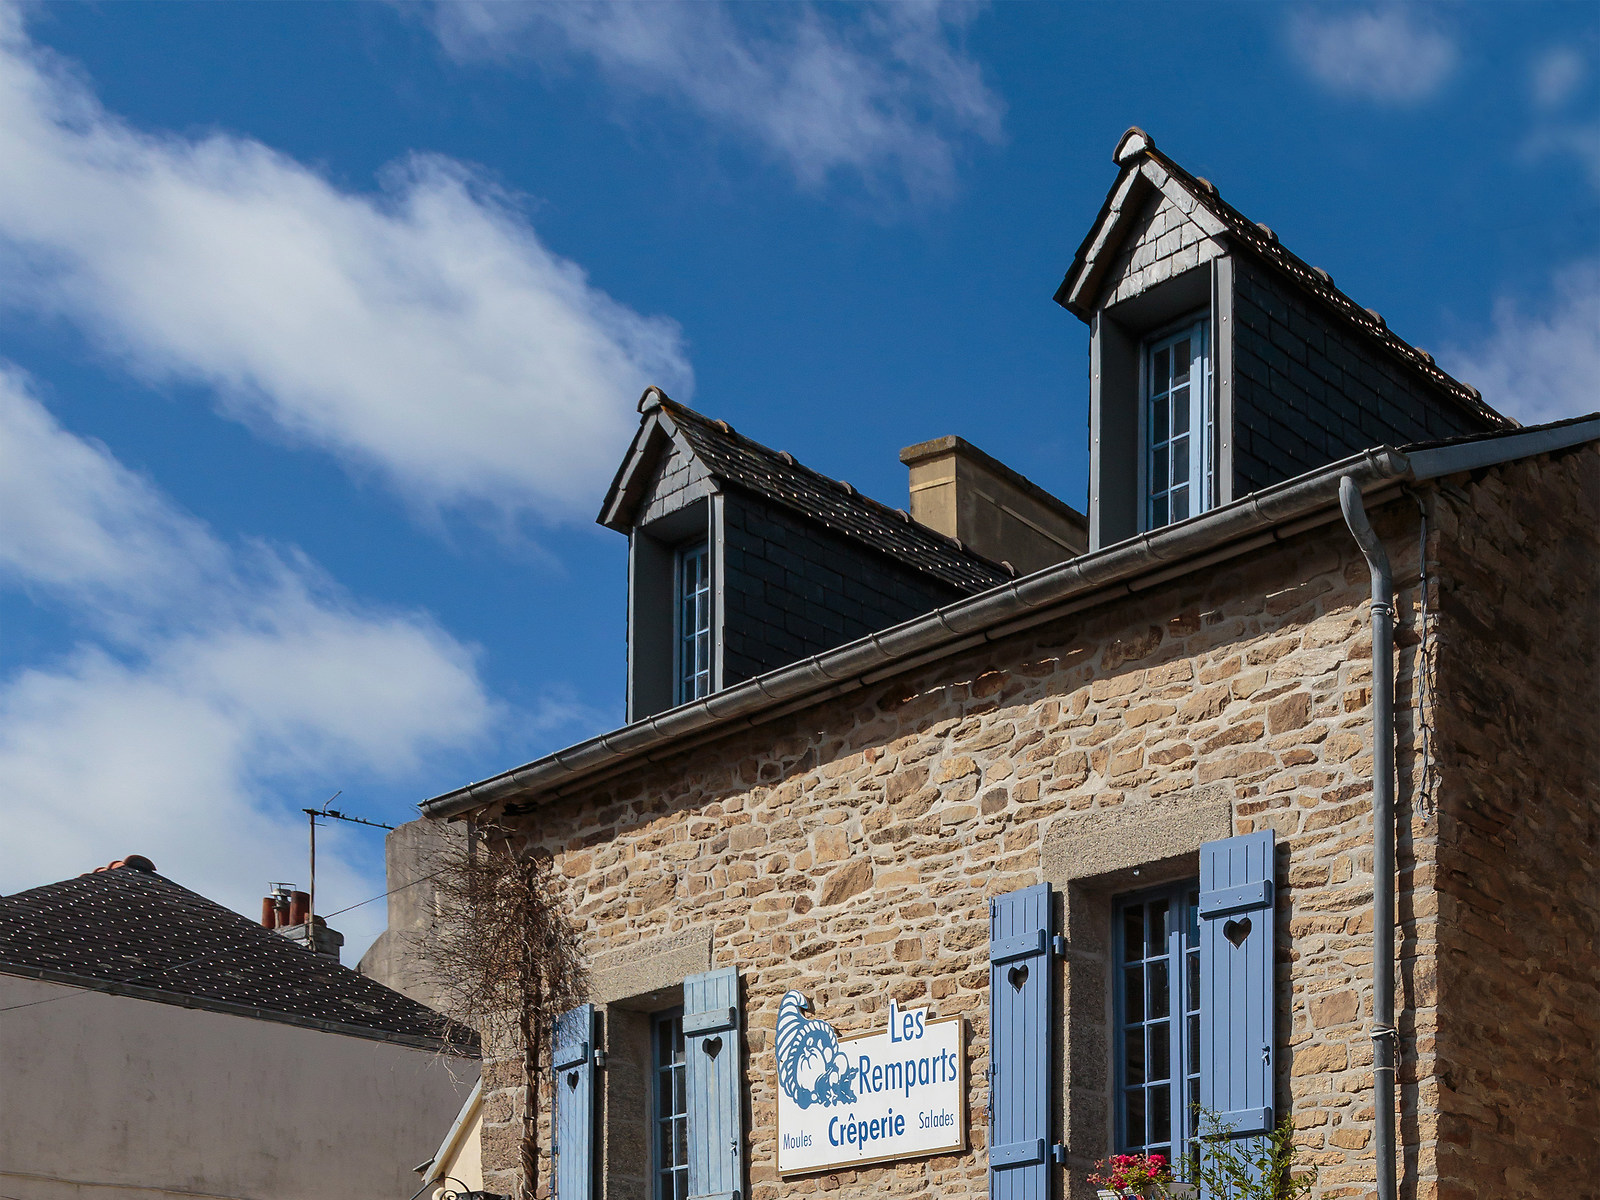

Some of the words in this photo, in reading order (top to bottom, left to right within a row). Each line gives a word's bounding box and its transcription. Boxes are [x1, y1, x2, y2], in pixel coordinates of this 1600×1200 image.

[891, 1003, 924, 1043] Les
[859, 1048, 957, 1098] Remparts
[782, 1130, 812, 1150] Moules
[828, 1108, 905, 1150] Crêperie
[918, 1108, 954, 1130] Salades
